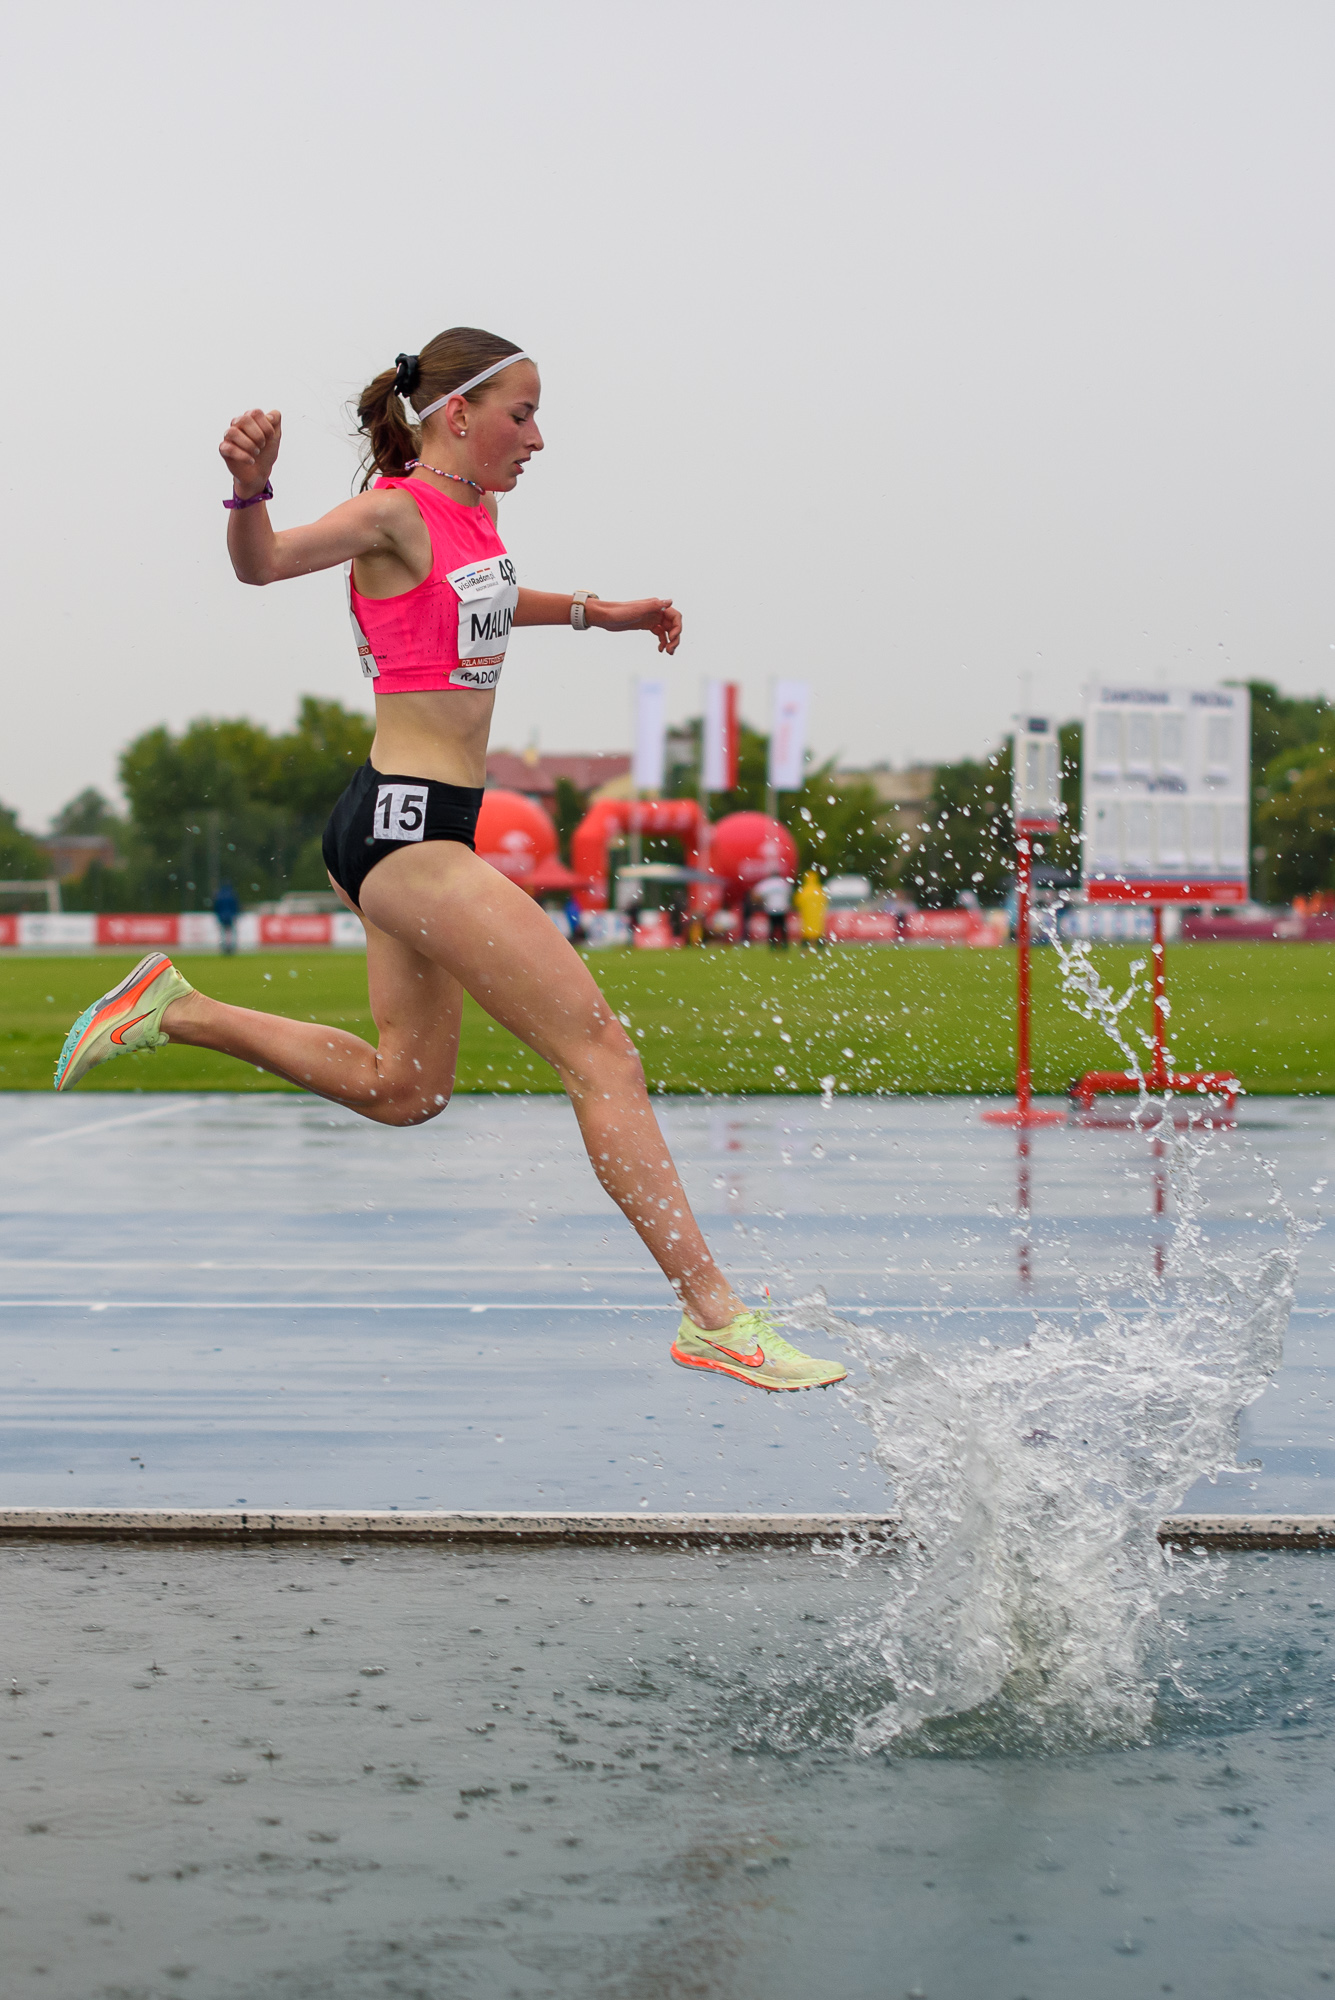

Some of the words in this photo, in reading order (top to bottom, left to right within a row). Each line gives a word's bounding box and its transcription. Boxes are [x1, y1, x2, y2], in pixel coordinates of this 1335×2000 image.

[470, 606, 516, 642] MALIN
[461, 659, 477, 667] PZLA
[377, 792, 424, 831] 15
